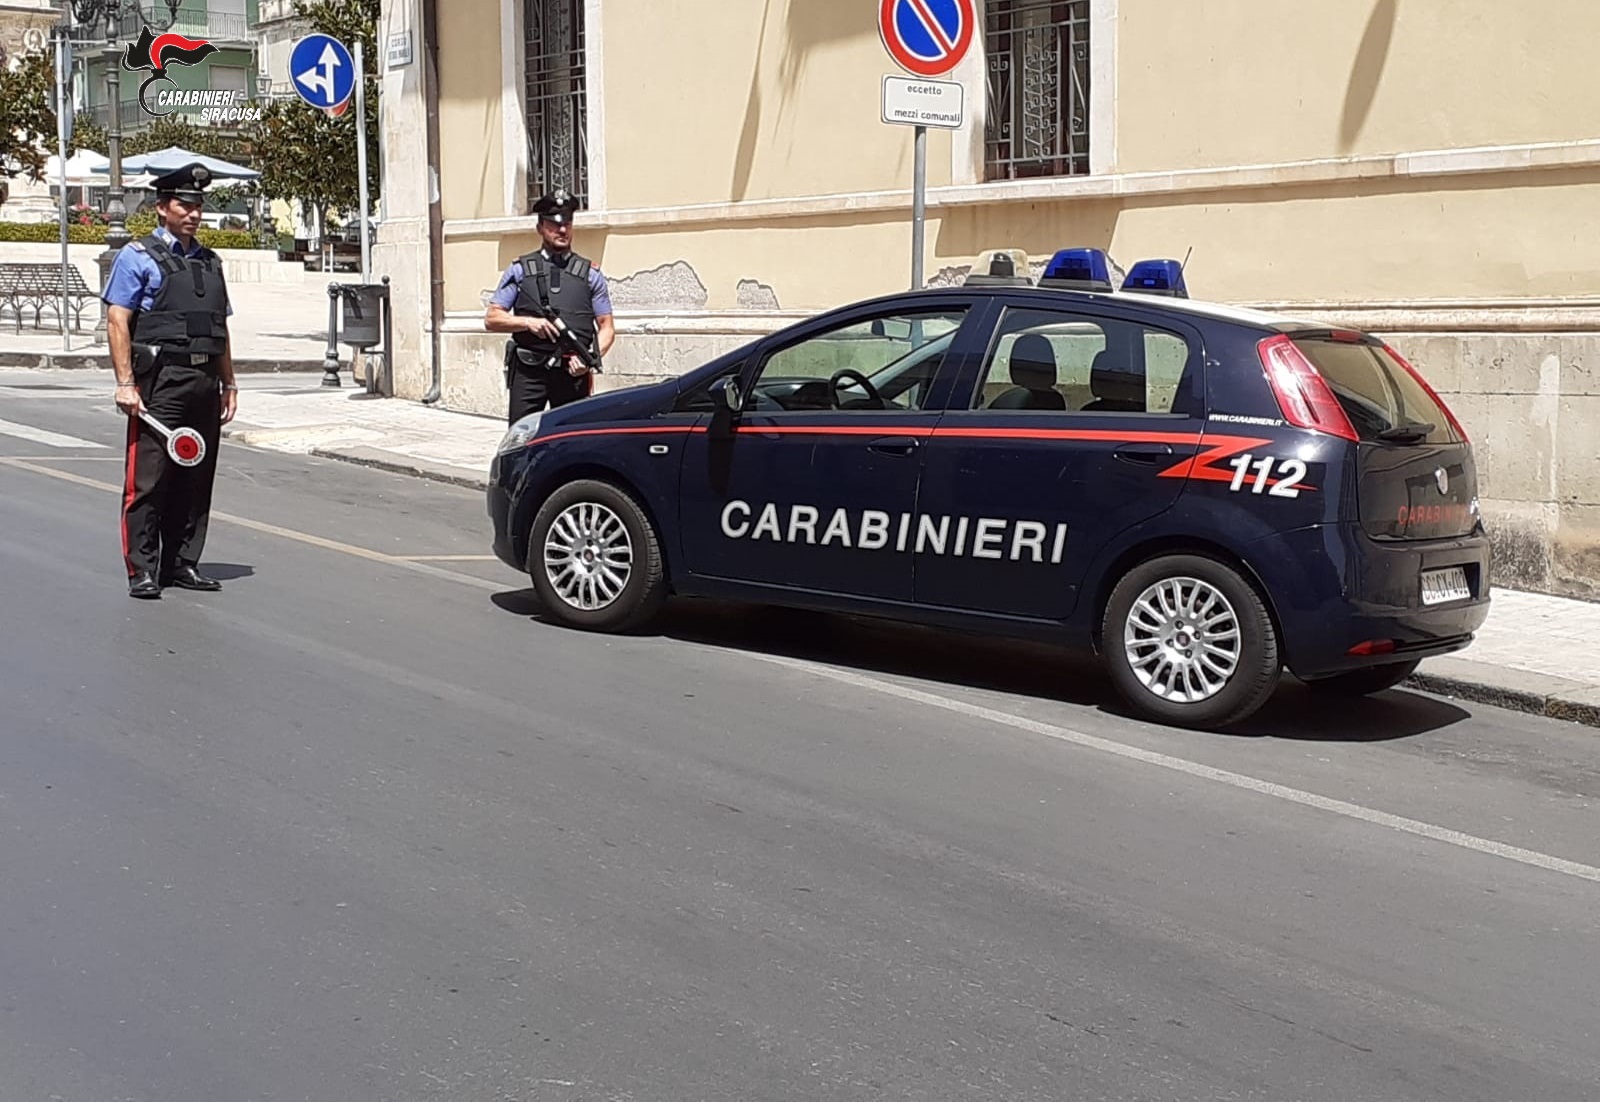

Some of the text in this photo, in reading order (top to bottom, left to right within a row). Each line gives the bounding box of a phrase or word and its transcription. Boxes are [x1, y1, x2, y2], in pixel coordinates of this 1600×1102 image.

[907, 85, 942, 95] eccetto
[894, 109, 960, 122] mezzi comunali
[1229, 454, 1308, 498] 112
[721, 500, 1067, 564] CARABINIERI
